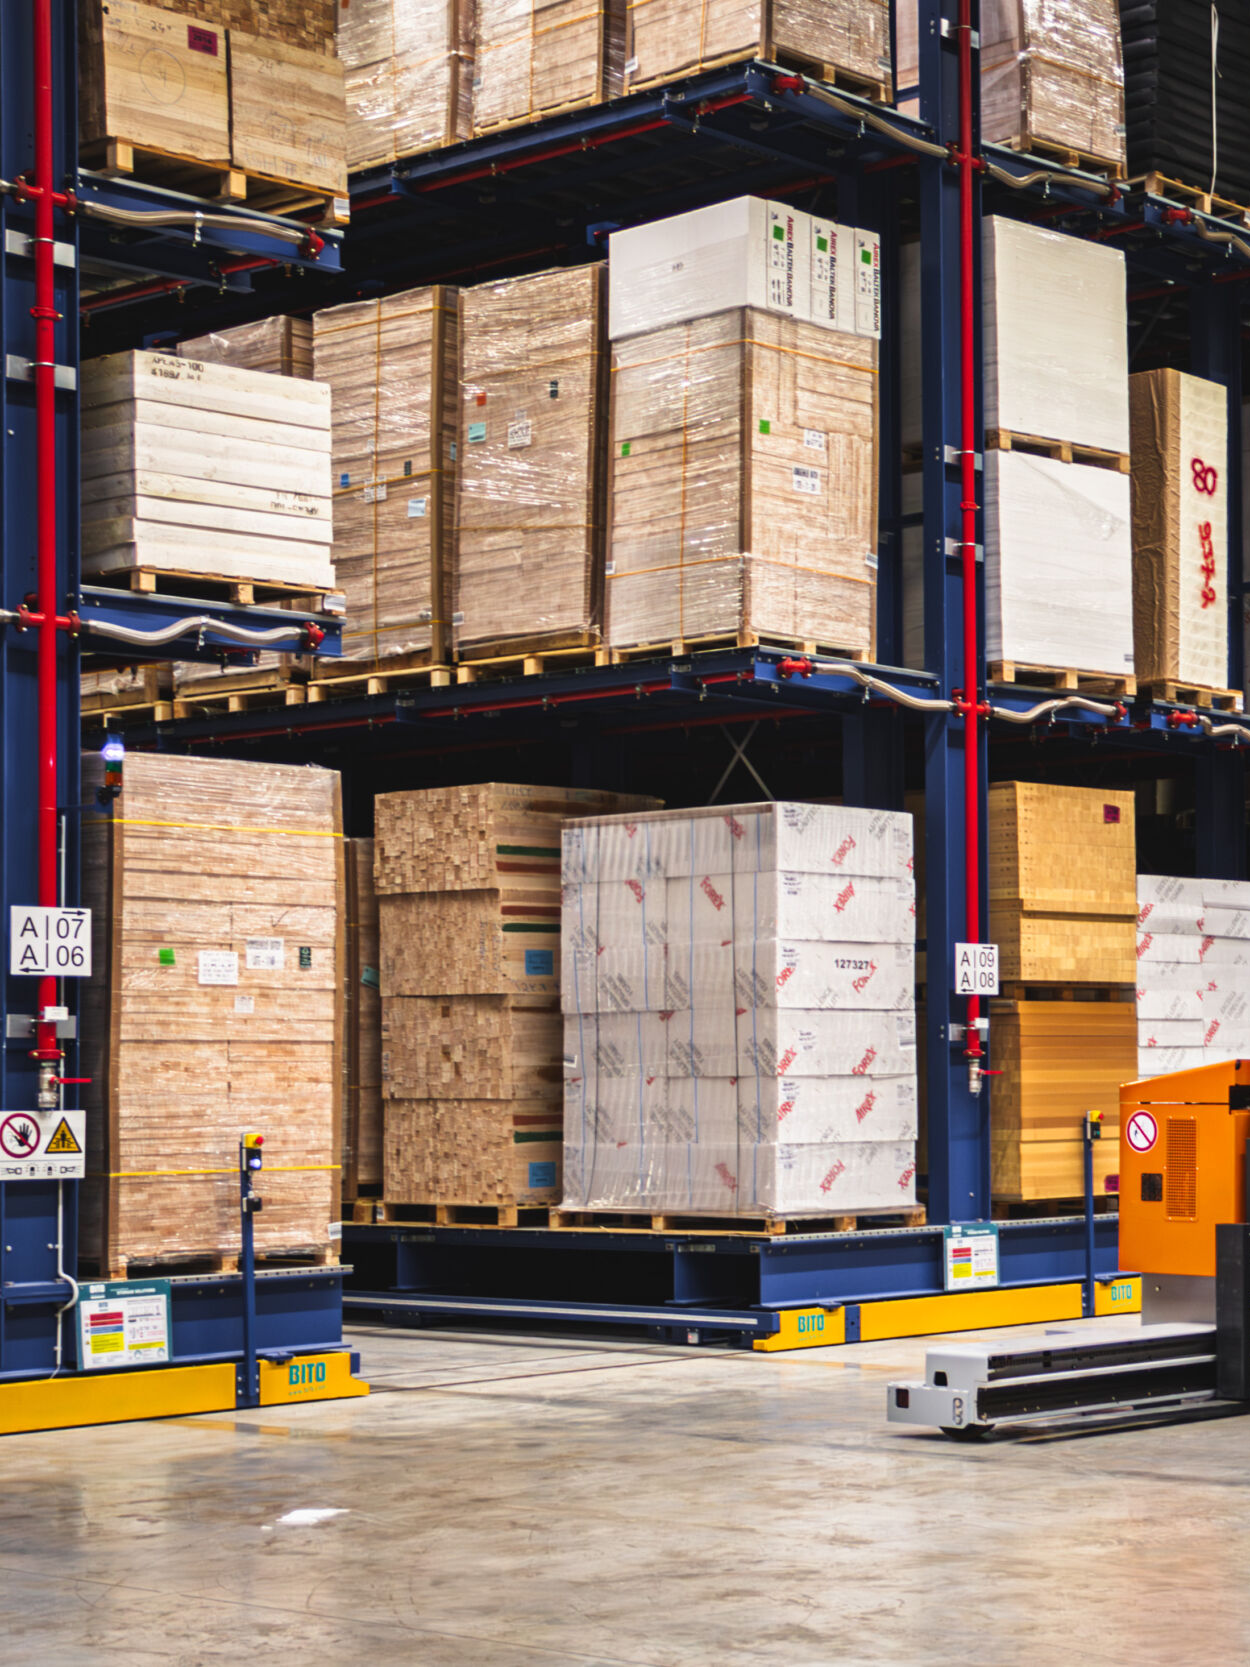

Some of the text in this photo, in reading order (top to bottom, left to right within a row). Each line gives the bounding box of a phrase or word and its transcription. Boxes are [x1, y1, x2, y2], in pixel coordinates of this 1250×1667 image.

[830, 834, 857, 867] FOREX
[700, 875, 727, 912] FOREX
[833, 880, 856, 914] AIREX
[20, 916, 84, 939] A 07
[20, 944, 84, 967] A 06
[834, 958, 870, 970] 127327
[960, 951, 995, 968] A 09
[960, 971, 995, 988] A 08
[776, 1046, 798, 1076] OREX
[855, 1089, 877, 1125] AIREX
[819, 1158, 846, 1195] FOREX
[1110, 1284, 1133, 1301] BITO
[797, 1313, 825, 1333] BITO
[288, 1361, 327, 1386] BITO
